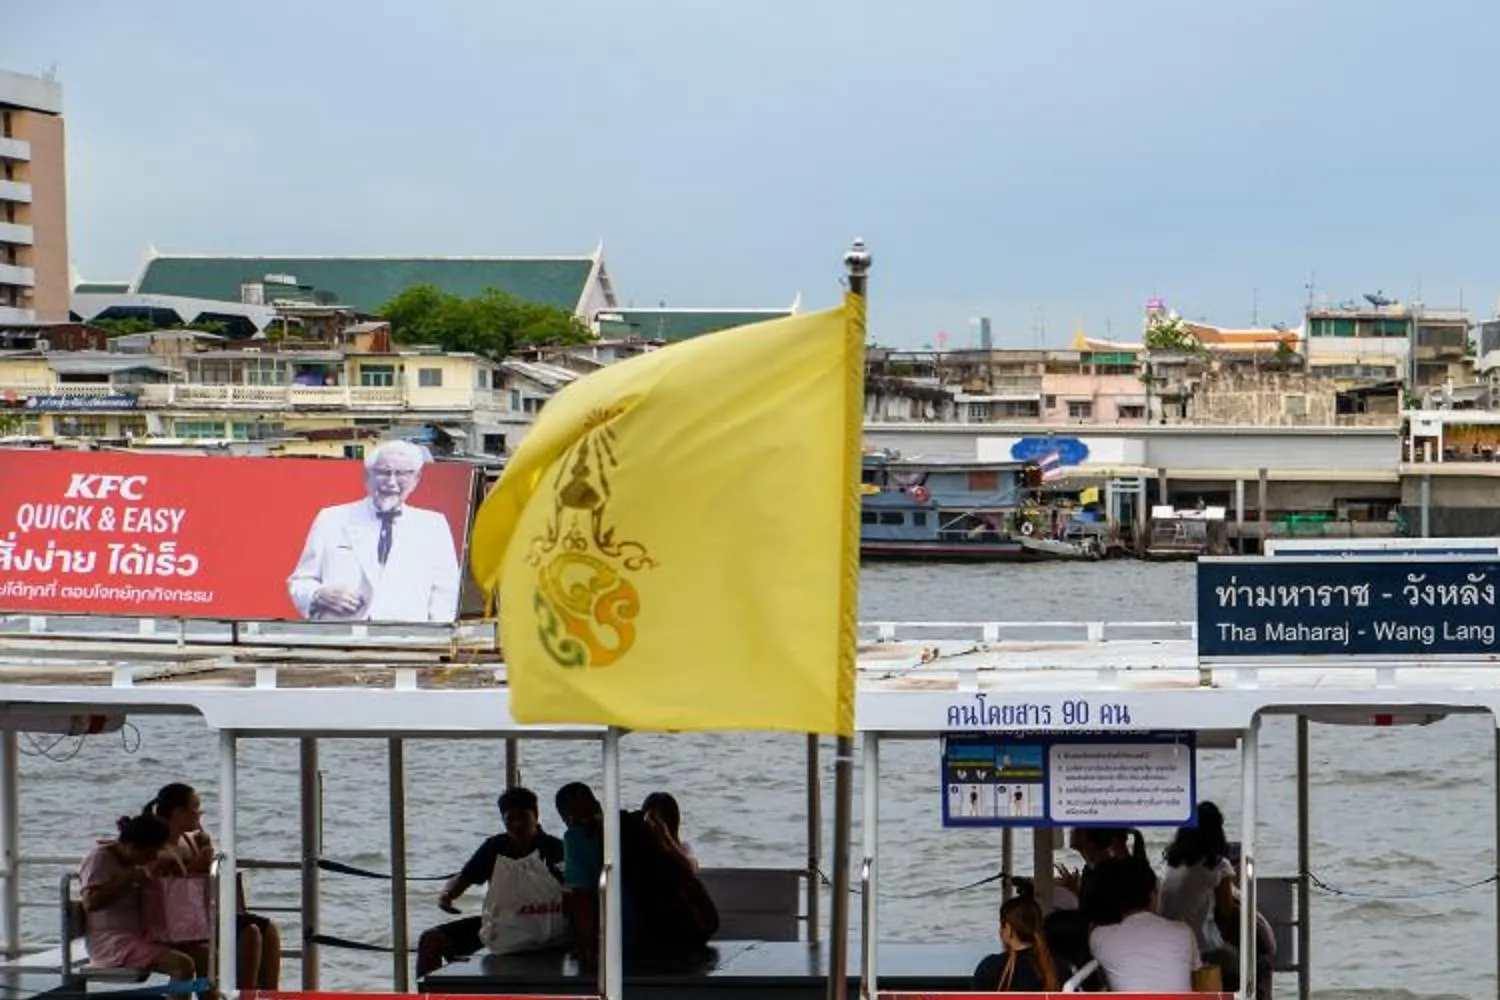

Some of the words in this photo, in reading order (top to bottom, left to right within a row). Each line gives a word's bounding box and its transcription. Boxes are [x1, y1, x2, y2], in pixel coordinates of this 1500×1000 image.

[64, 473, 148, 500] KFC
[16, 504, 93, 532] QUICK
[98, 506, 116, 531] &
[123, 507, 187, 533] EASY
[107, 541, 199, 576] ได้เร็ว
[1215, 575, 1371, 607] ท่ามหาราช
[1403, 572, 1496, 607] วังหลัง
[1216, 623, 1257, 642] Tha
[1265, 622, 1350, 645] Maharaj
[1374, 622, 1435, 645] Wang
[1443, 621, 1495, 645] Lang
[947, 693, 1052, 727] คนโดยสาร
[1062, 700, 1090, 726] 90
[1100, 703, 1131, 726] คน
